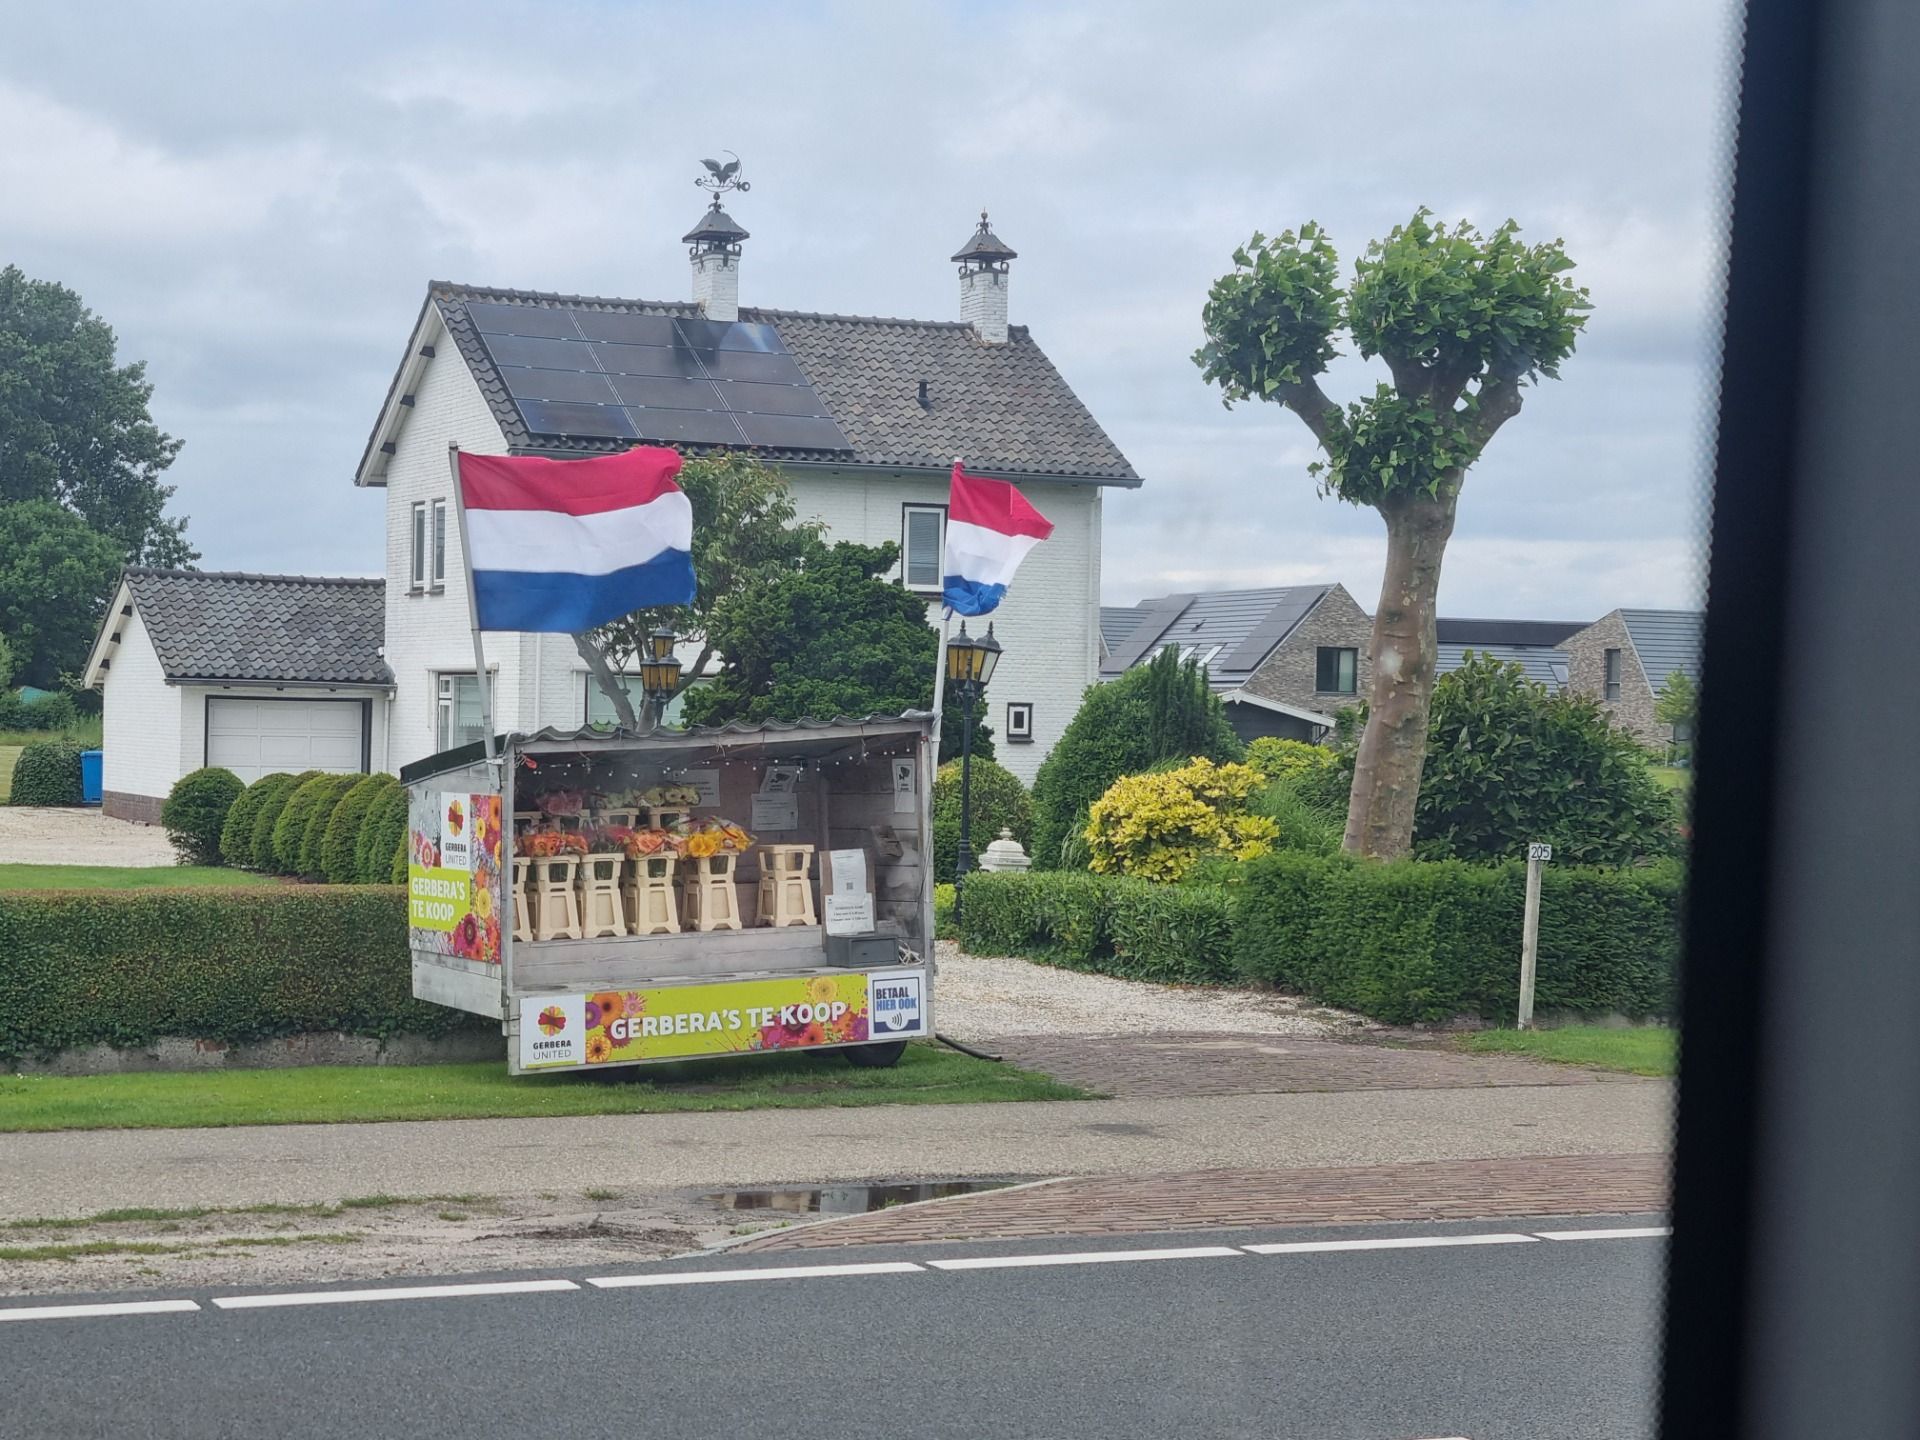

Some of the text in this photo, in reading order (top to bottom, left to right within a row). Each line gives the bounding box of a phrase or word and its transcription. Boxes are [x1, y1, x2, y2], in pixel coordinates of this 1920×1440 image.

[445, 843, 467, 853] GERBERA
[1531, 846, 1549, 858] 205
[445, 854, 467, 866] UNITED
[412, 878, 465, 901] GERBERA'S
[412, 901, 454, 921] TE KOOP
[876, 986, 909, 999] BETAAL
[876, 998, 917, 1011] HIER OOK
[610, 1001, 847, 1039] GERBERA'S TE KOOP
[533, 1040, 571, 1049] GERBERA
[533, 1049, 571, 1060] UNITED
